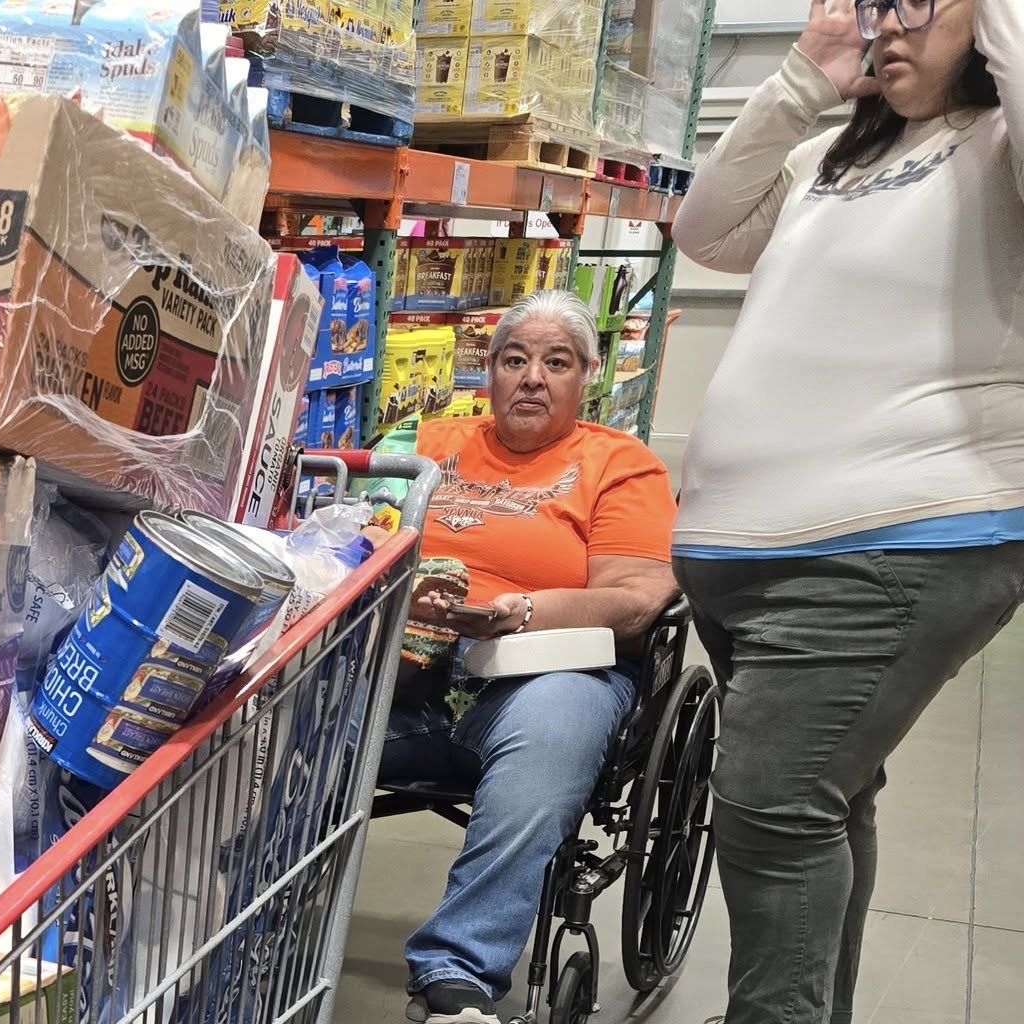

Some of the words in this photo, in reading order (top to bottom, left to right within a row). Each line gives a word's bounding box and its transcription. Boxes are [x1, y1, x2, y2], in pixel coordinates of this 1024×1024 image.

[417, 272, 452, 282] BREAKFAST
[132, 313, 148, 332] NO
[160, 288, 195, 325] VARIETY
[196, 307, 218, 339] PACK
[416, 315, 431, 323] PACK
[120, 334, 154, 352] ADDED
[125, 352, 146, 371] MSG
[247, 392, 282, 518] SAUCE
[38, 701, 68, 737] Chunk
